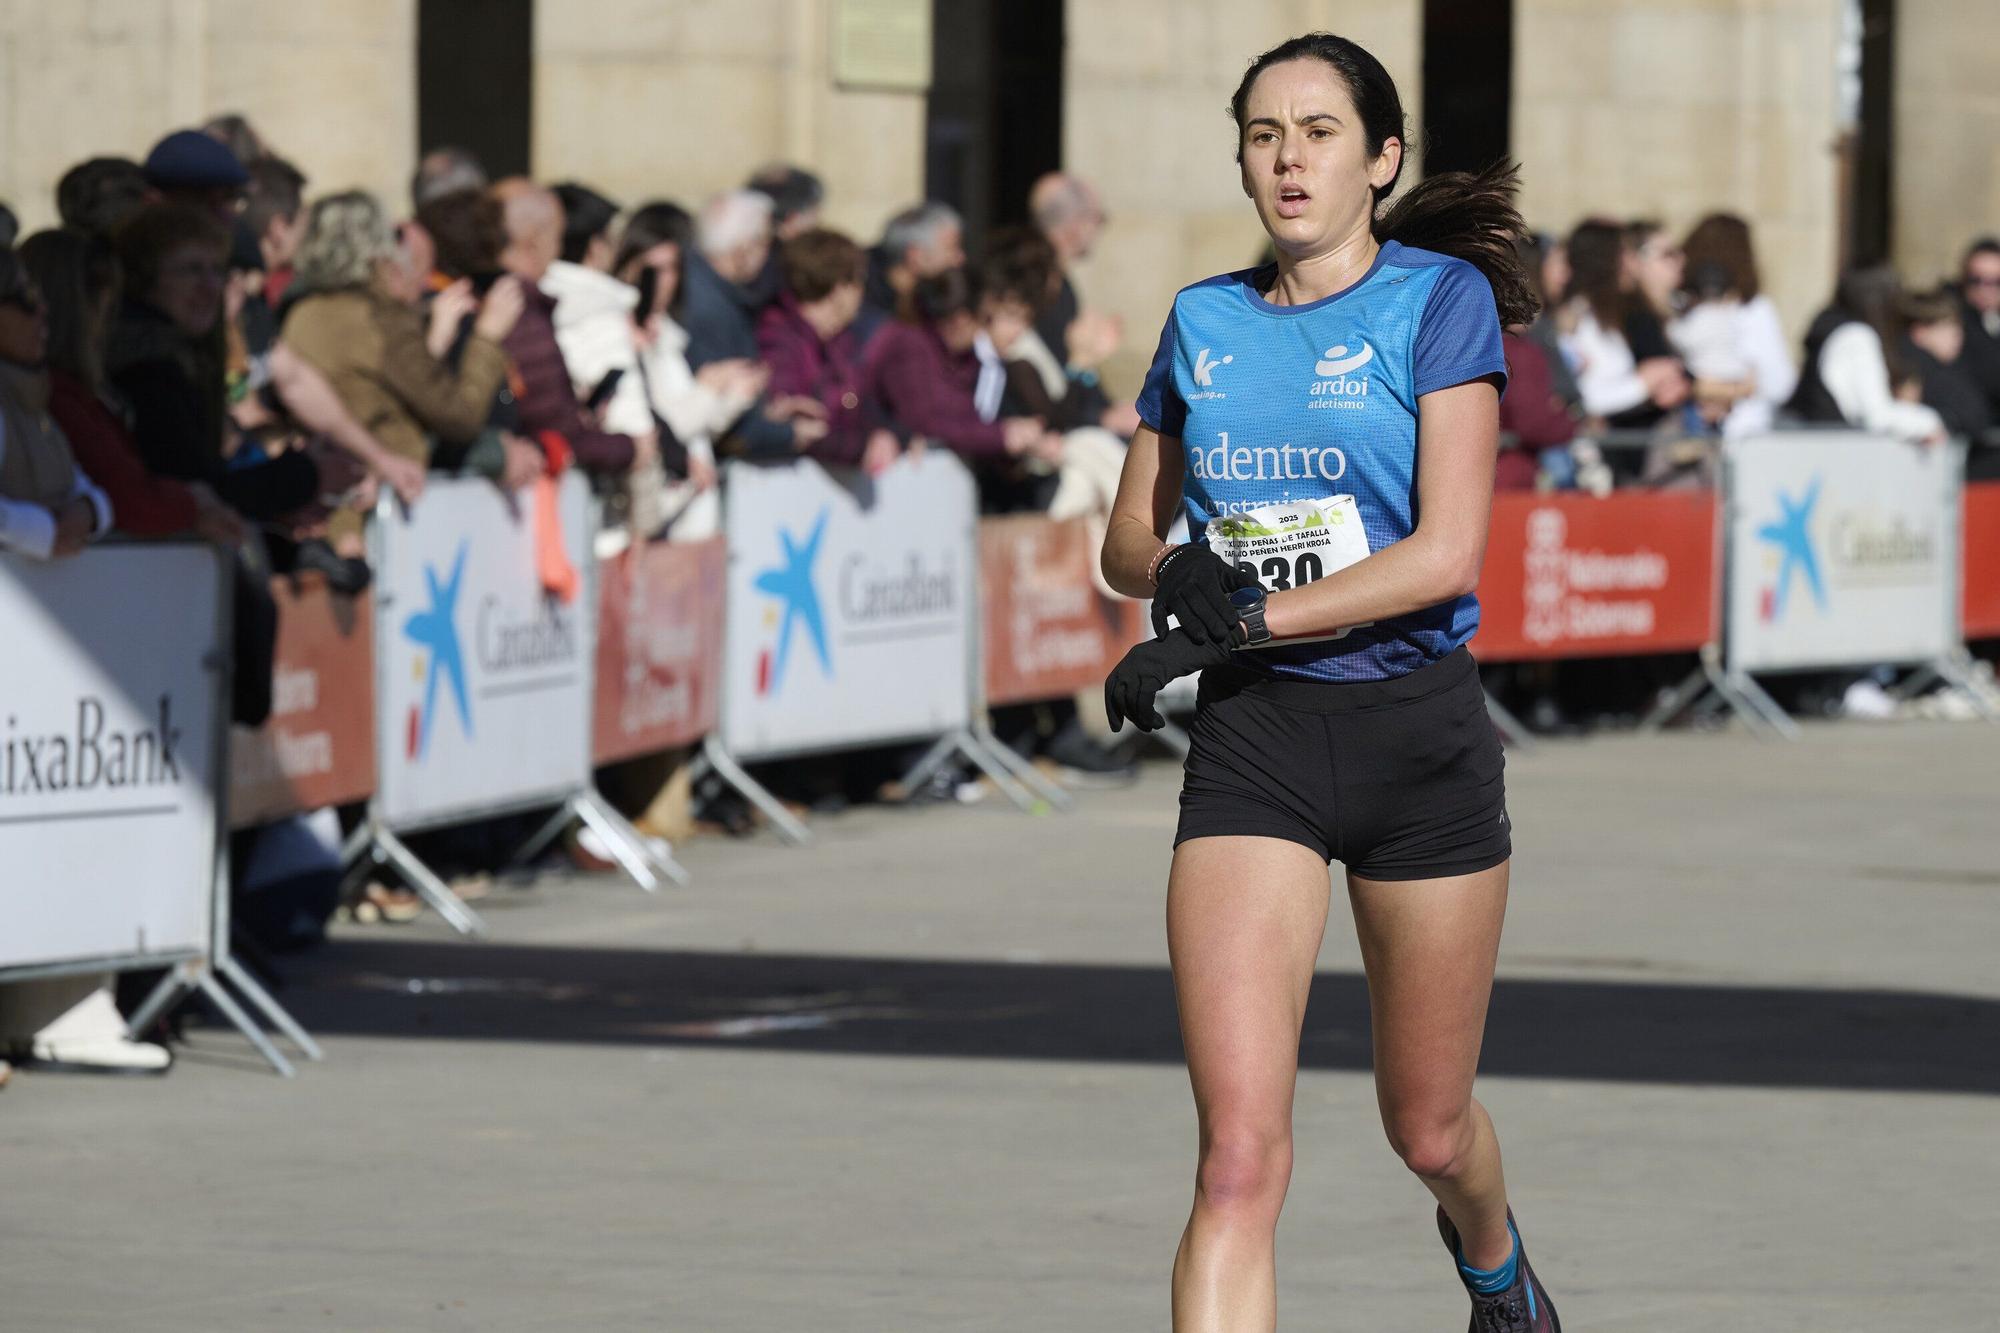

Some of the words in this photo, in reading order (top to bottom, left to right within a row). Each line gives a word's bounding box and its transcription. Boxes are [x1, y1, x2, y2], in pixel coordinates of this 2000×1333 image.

[1310, 375, 1368, 396] ardoi
[1308, 398, 1364, 409] atletismo
[1191, 432, 1346, 480] adentro
[1279, 515, 1299, 524] 2025
[1250, 546, 1279, 557] PEÑEN
[1280, 542, 1306, 554] HERRI
[1307, 538, 1331, 549] KROSA
[1252, 537, 1279, 548] PEÑAS
[1282, 533, 1294, 543] DE
[1296, 528, 1330, 541] TAFALLA
[0, 692, 182, 794] ixaBank
